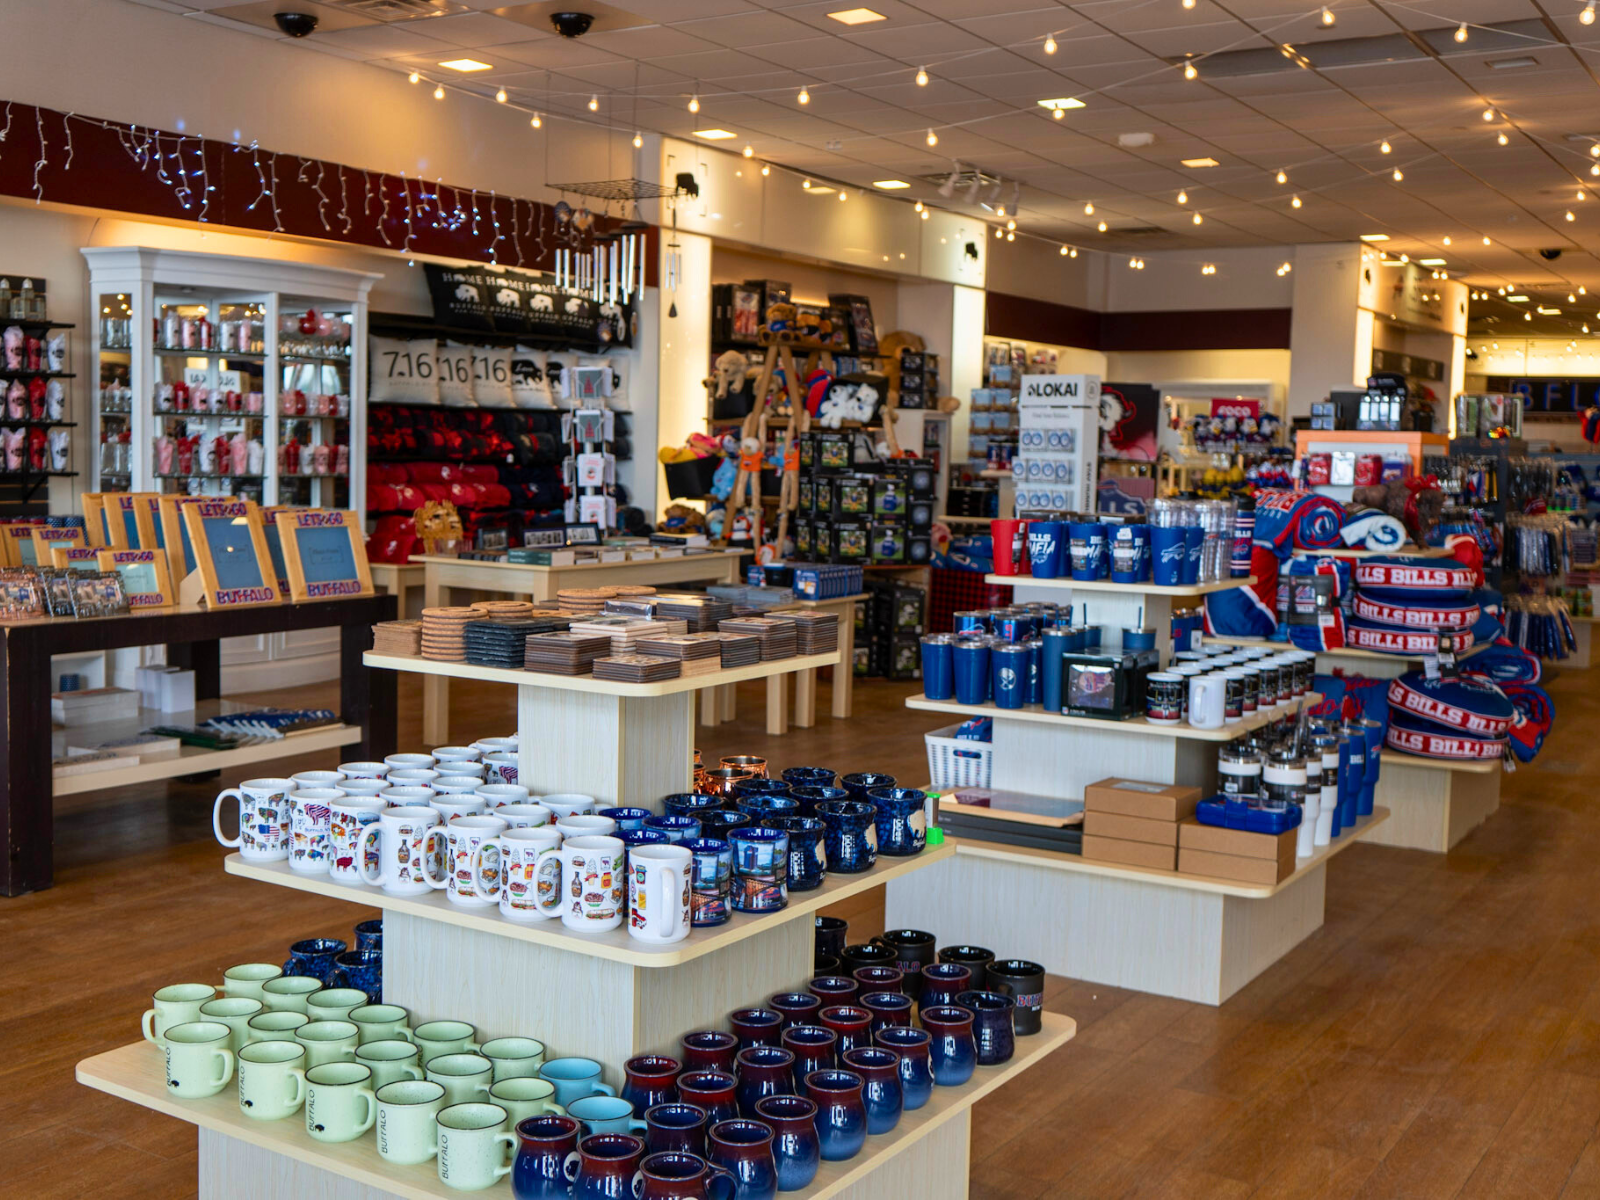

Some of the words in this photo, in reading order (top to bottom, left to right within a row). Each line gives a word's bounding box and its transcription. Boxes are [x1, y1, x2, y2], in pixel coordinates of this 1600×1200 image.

[437, 357, 468, 383] 16
[1036, 382, 1078, 397] LOKAI
[1390, 568, 1449, 586] BILLS
[216, 586, 274, 605] BUFFALO
[307, 580, 362, 597] BUFFALO
[128, 593, 164, 605] UFFALO
[1360, 602, 1404, 621] BILLS
[1405, 610, 1462, 627] BILLS
[1405, 692, 1463, 724] BILLS
[308, 1089, 316, 1132] BUFFALO
[379, 1109, 388, 1154] BUFFALO
[441, 1134, 449, 1179] BUFFALO
